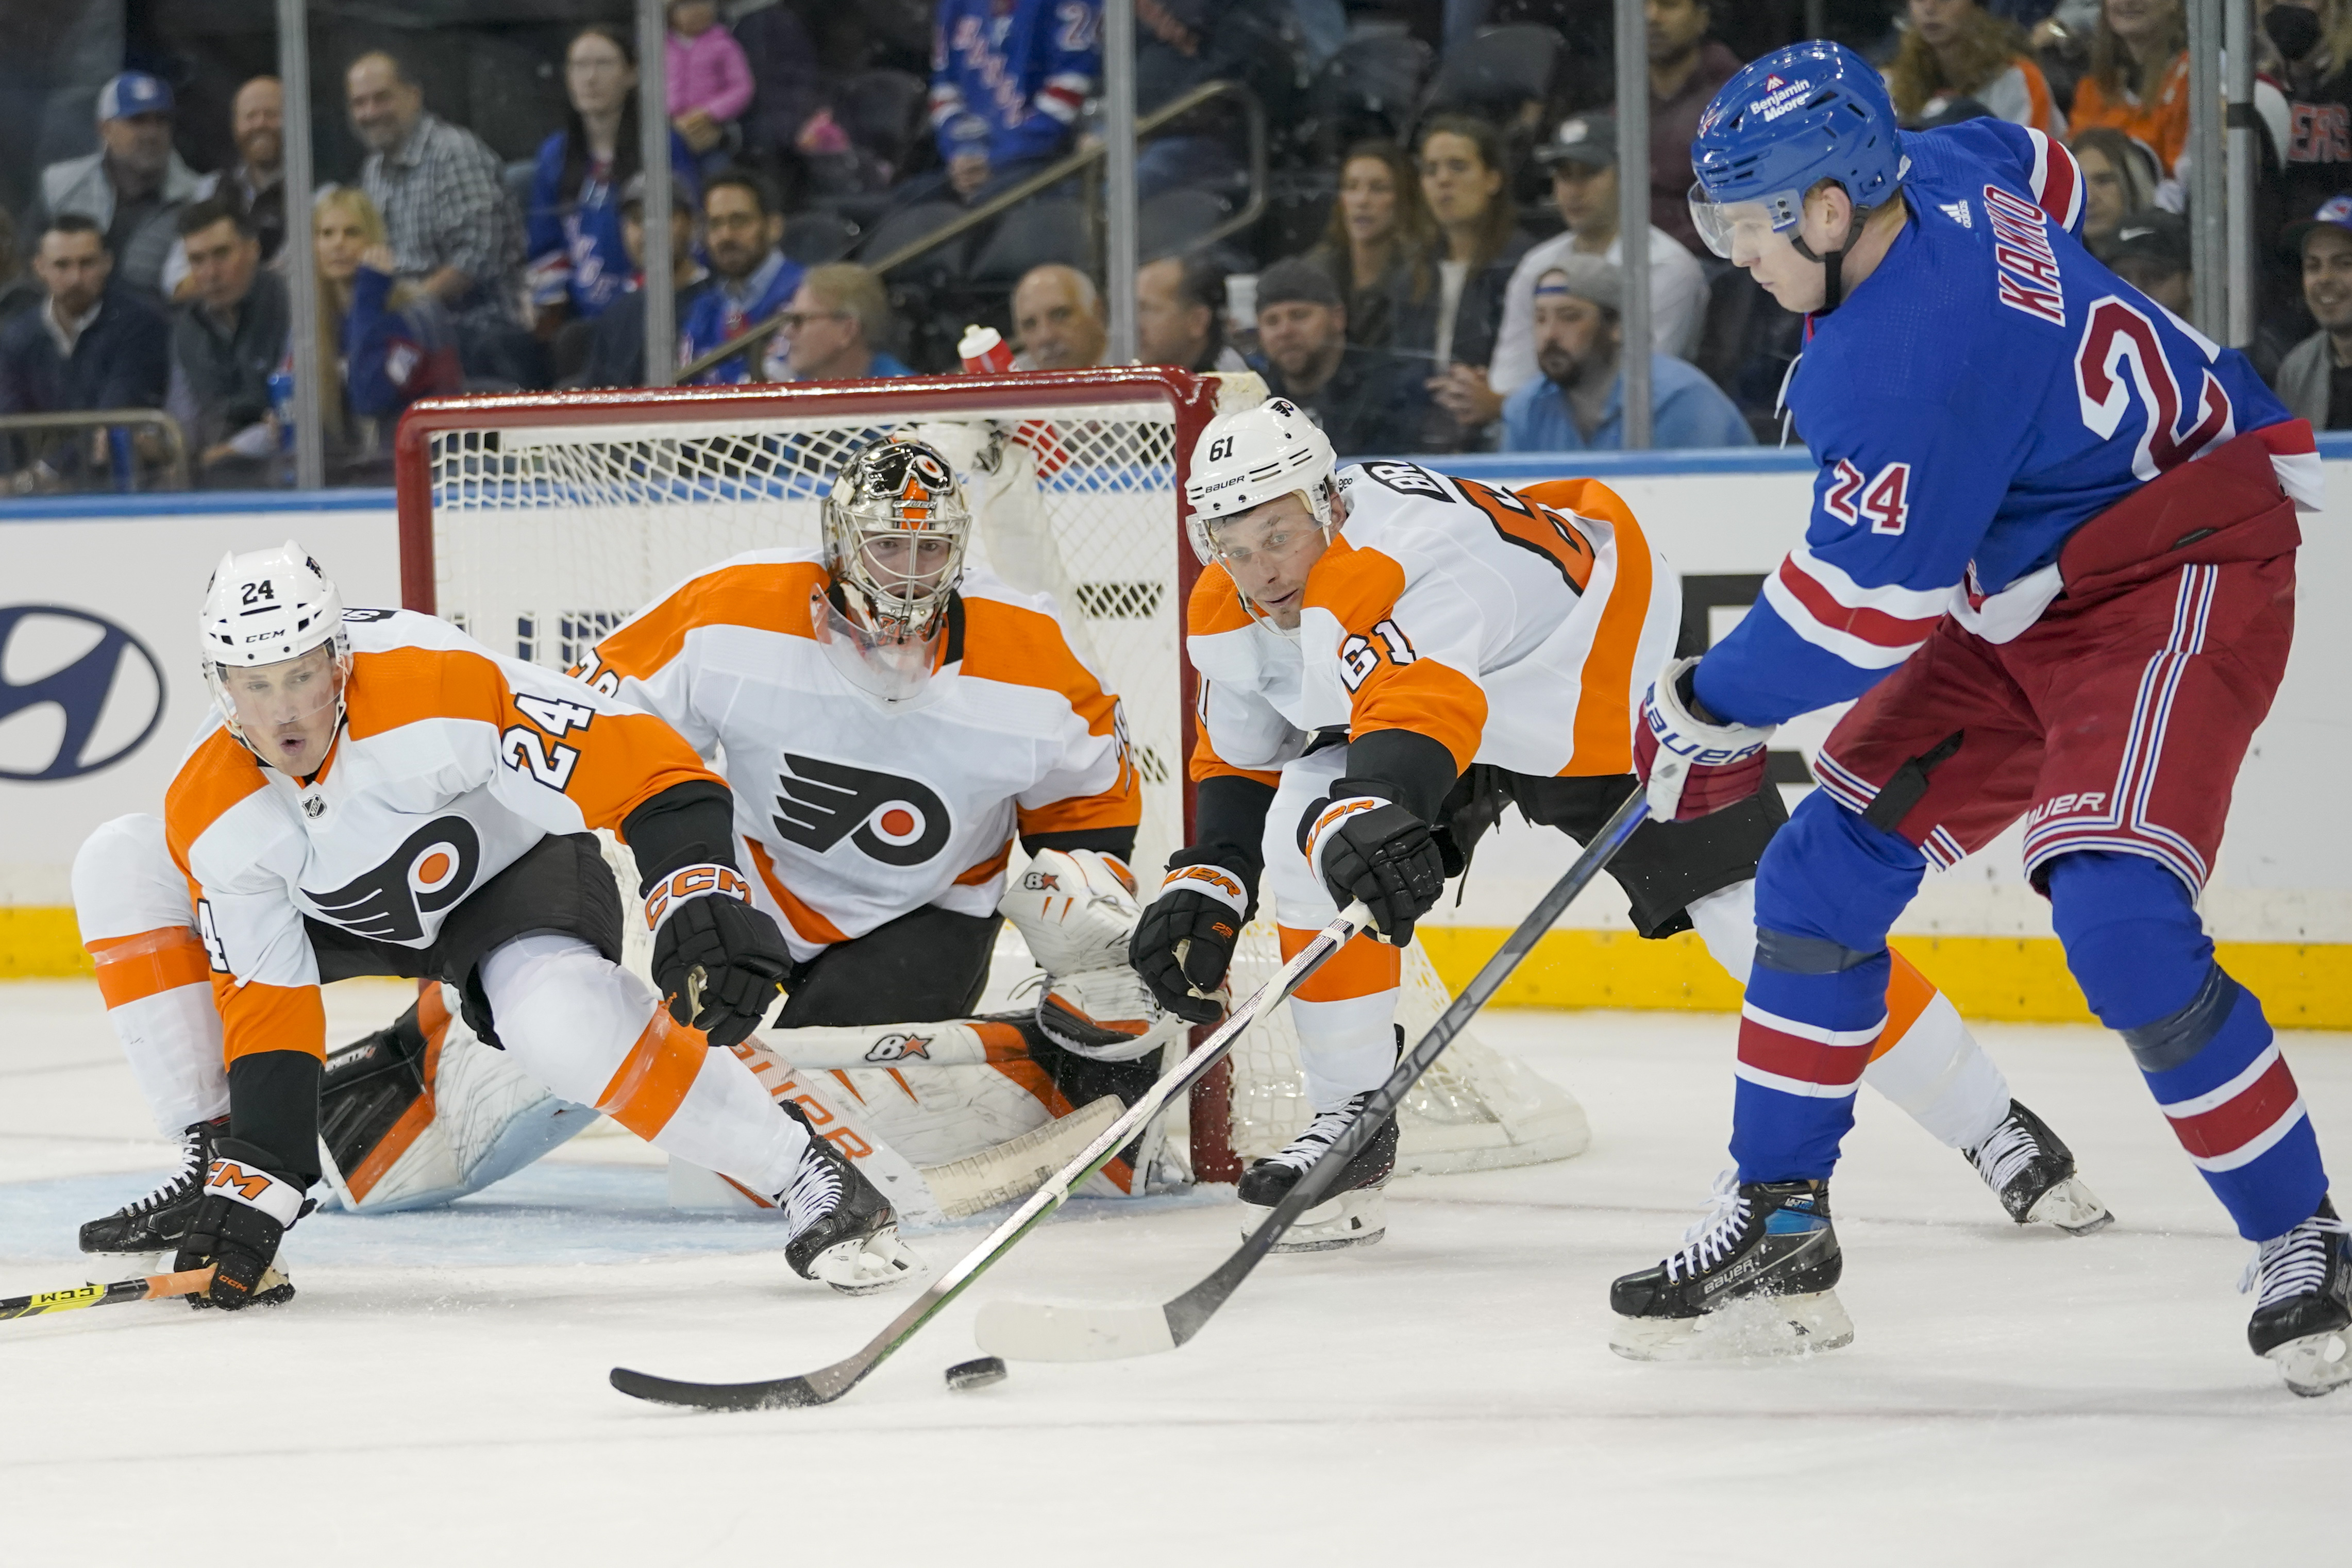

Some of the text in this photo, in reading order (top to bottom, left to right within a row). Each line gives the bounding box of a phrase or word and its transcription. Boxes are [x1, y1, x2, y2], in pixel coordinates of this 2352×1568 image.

[1750, 78, 1810, 115] Benjamin
[1763, 94, 1806, 122] Moore
[1959, 199, 1972, 228] adidas
[1983, 183, 2066, 327] KAKKO
[1209, 435, 1234, 462] 61
[1824, 458, 1910, 536] 24
[241, 580, 275, 605] 24
[245, 629, 285, 644] CCM
[1340, 619, 1416, 694] 61
[501, 692, 596, 794] 24
[310, 798, 322, 816] NHL
[645, 867, 751, 931] CCM
[41, 1287, 95, 1303] CCM
[218, 1274, 248, 1292] CCM
